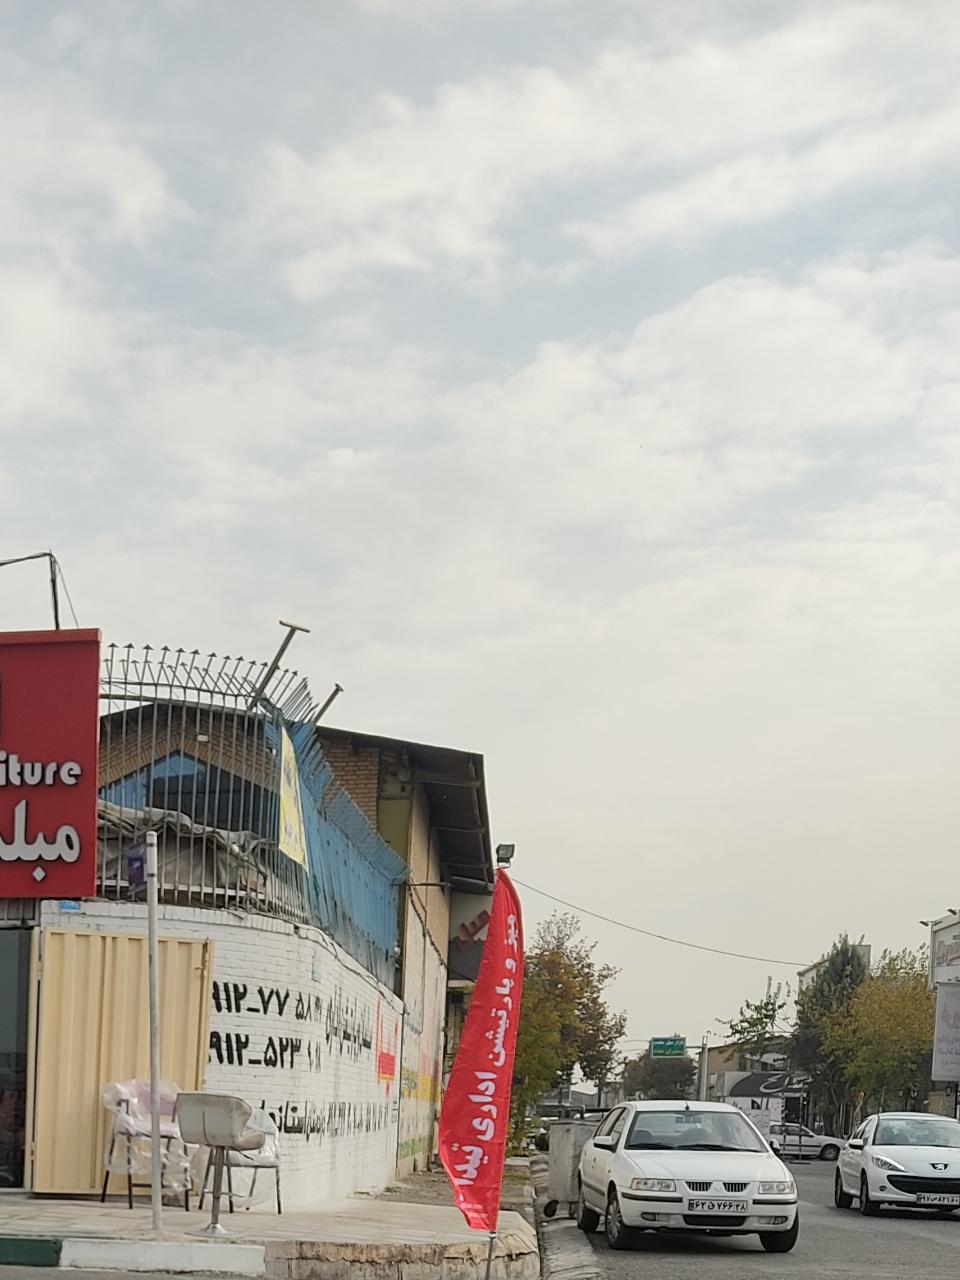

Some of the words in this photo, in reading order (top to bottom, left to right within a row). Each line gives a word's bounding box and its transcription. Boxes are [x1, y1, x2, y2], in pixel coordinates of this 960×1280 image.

[505, 958, 516, 973] و
[486, 977, 516, 1067] پارتیشن
[468, 1071, 498, 1142] اداری
[451, 1143, 490, 1187] تیدا
